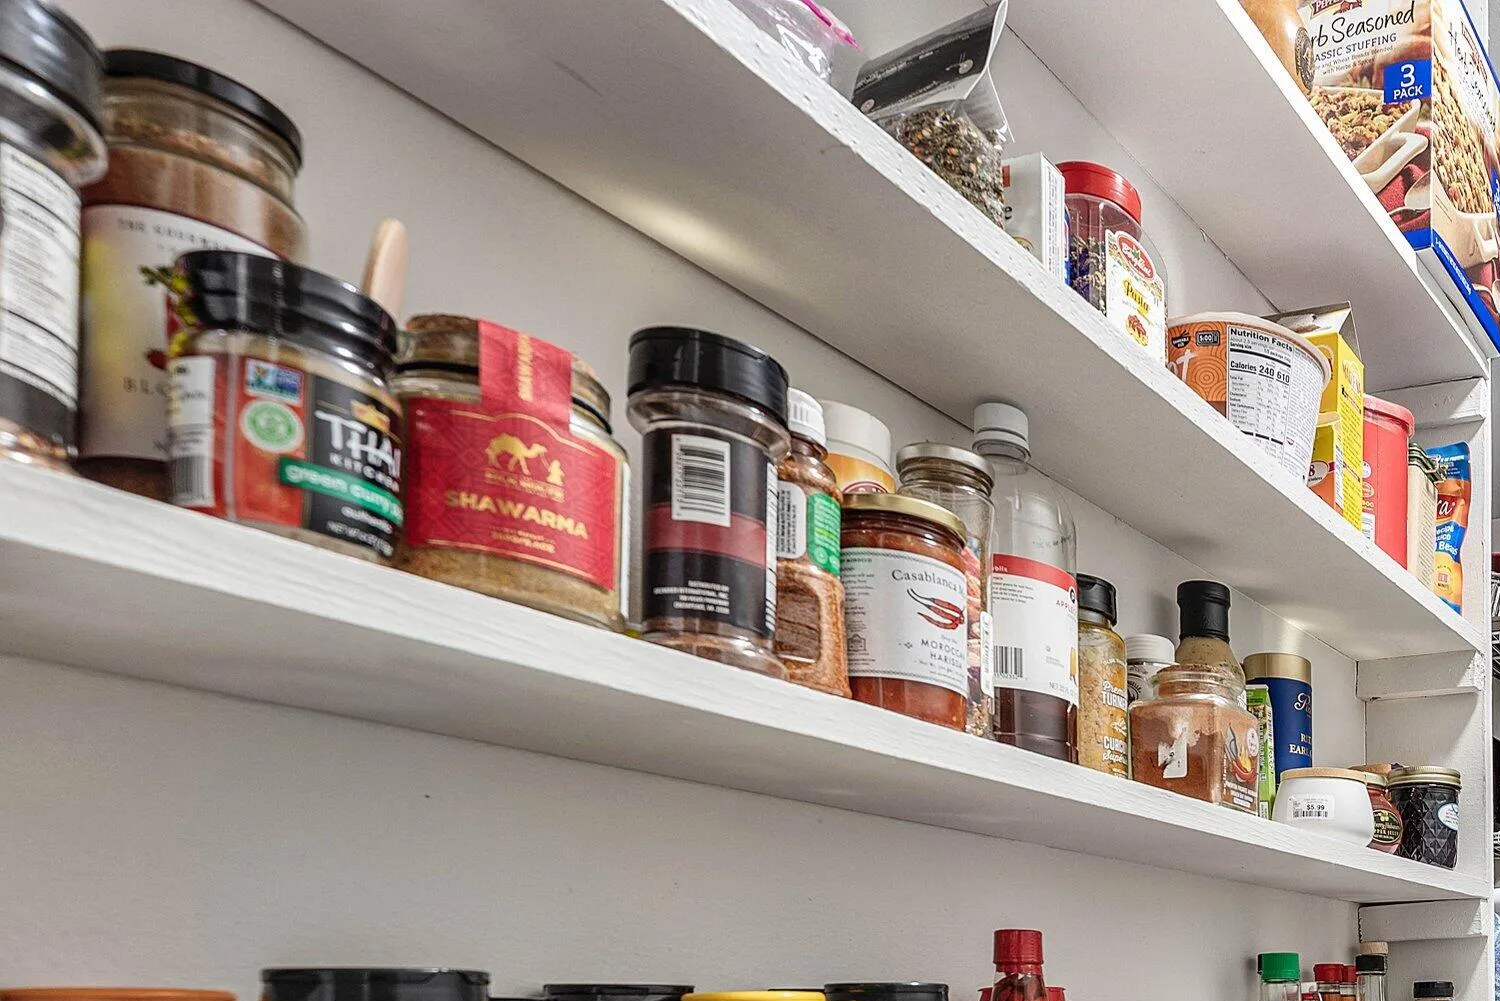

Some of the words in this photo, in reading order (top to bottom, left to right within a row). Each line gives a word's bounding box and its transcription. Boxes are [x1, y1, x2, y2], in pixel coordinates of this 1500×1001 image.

[1331, 1, 1415, 44] Seasoned
[1345, 32, 1397, 54] STUFFING
[1400, 63, 1415, 88] 3
[1393, 85, 1423, 100] PACK
[1230, 328, 1269, 343] Nutrition
[1271, 337, 1293, 352] Facts
[1230, 361, 1257, 373] Calories
[1258, 365, 1274, 378] 240
[1276, 372, 1290, 384] 610
[445, 489, 589, 540] SHAWARMA
[1439, 541, 1458, 556] Beans
[891, 569, 960, 594] Casablanca
[1306, 803, 1325, 812] $5.99
